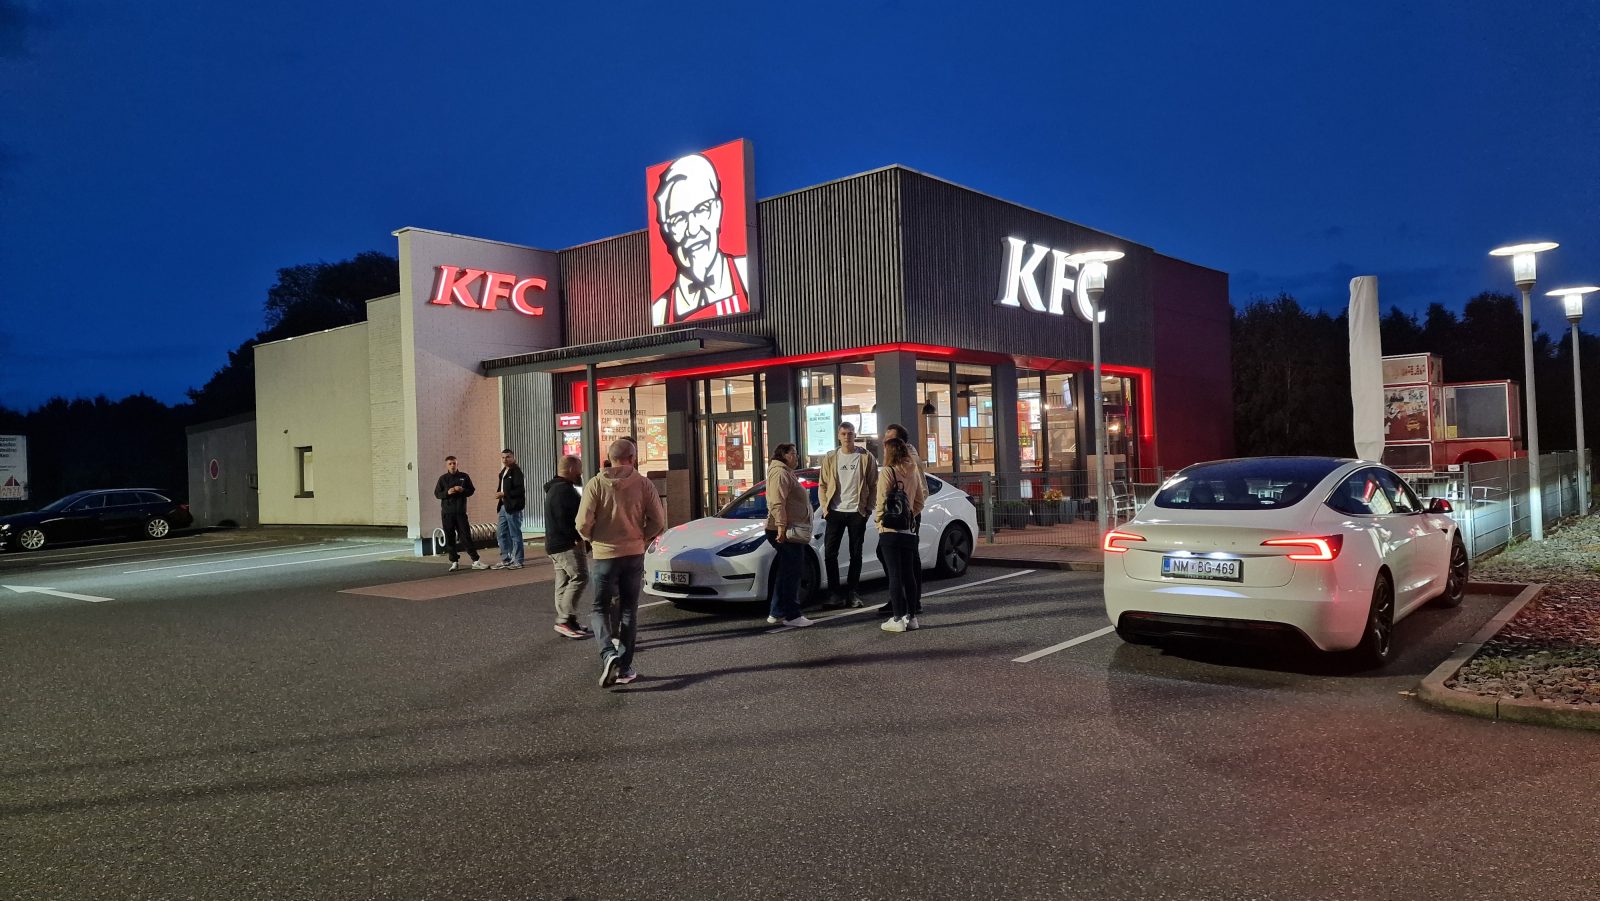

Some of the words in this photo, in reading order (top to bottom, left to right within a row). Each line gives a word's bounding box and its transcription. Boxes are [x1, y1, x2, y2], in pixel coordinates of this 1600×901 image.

[430, 265, 547, 316] KFC
[993, 237, 1107, 322] KFC
[1173, 560, 1189, 572] NM
[1198, 561, 1235, 575] BG-469
